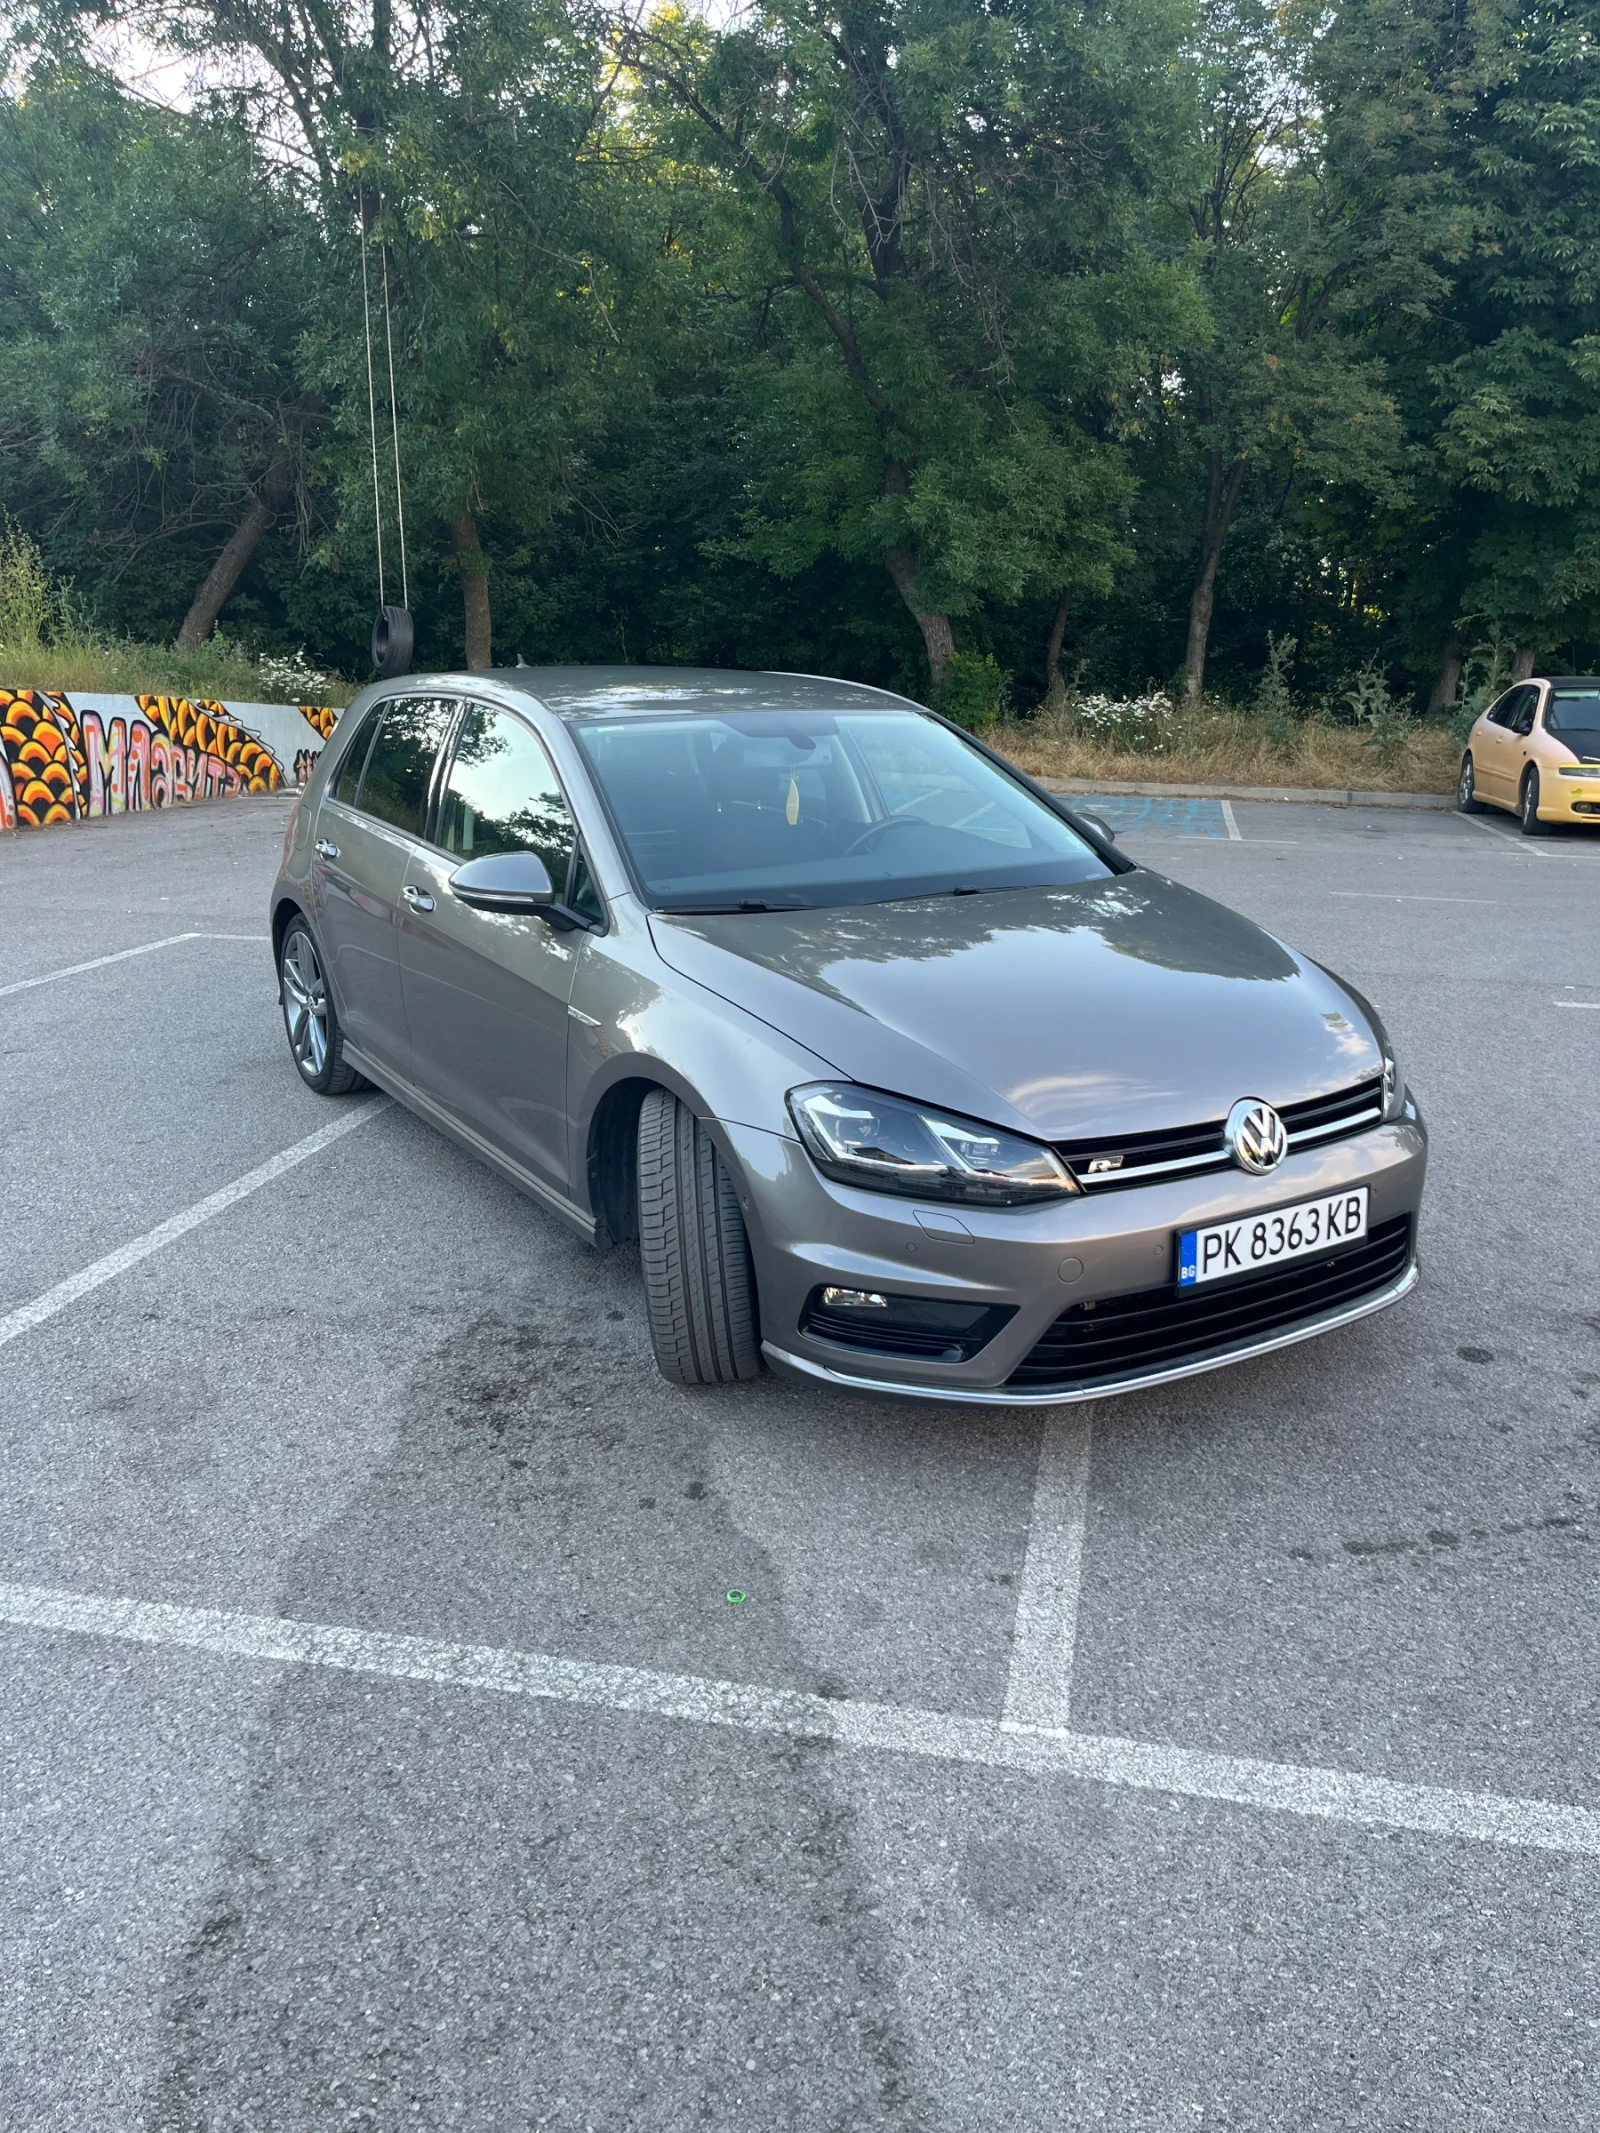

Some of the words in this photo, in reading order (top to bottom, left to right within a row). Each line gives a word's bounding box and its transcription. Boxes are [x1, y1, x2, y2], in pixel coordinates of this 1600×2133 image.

[1234, 1101, 1287, 1168] VW
[1203, 1226, 1241, 1274] PK
[1250, 1207, 1320, 1260] 8363
[1326, 1195, 1361, 1240] KB
[1181, 1264, 1196, 1280] BG
